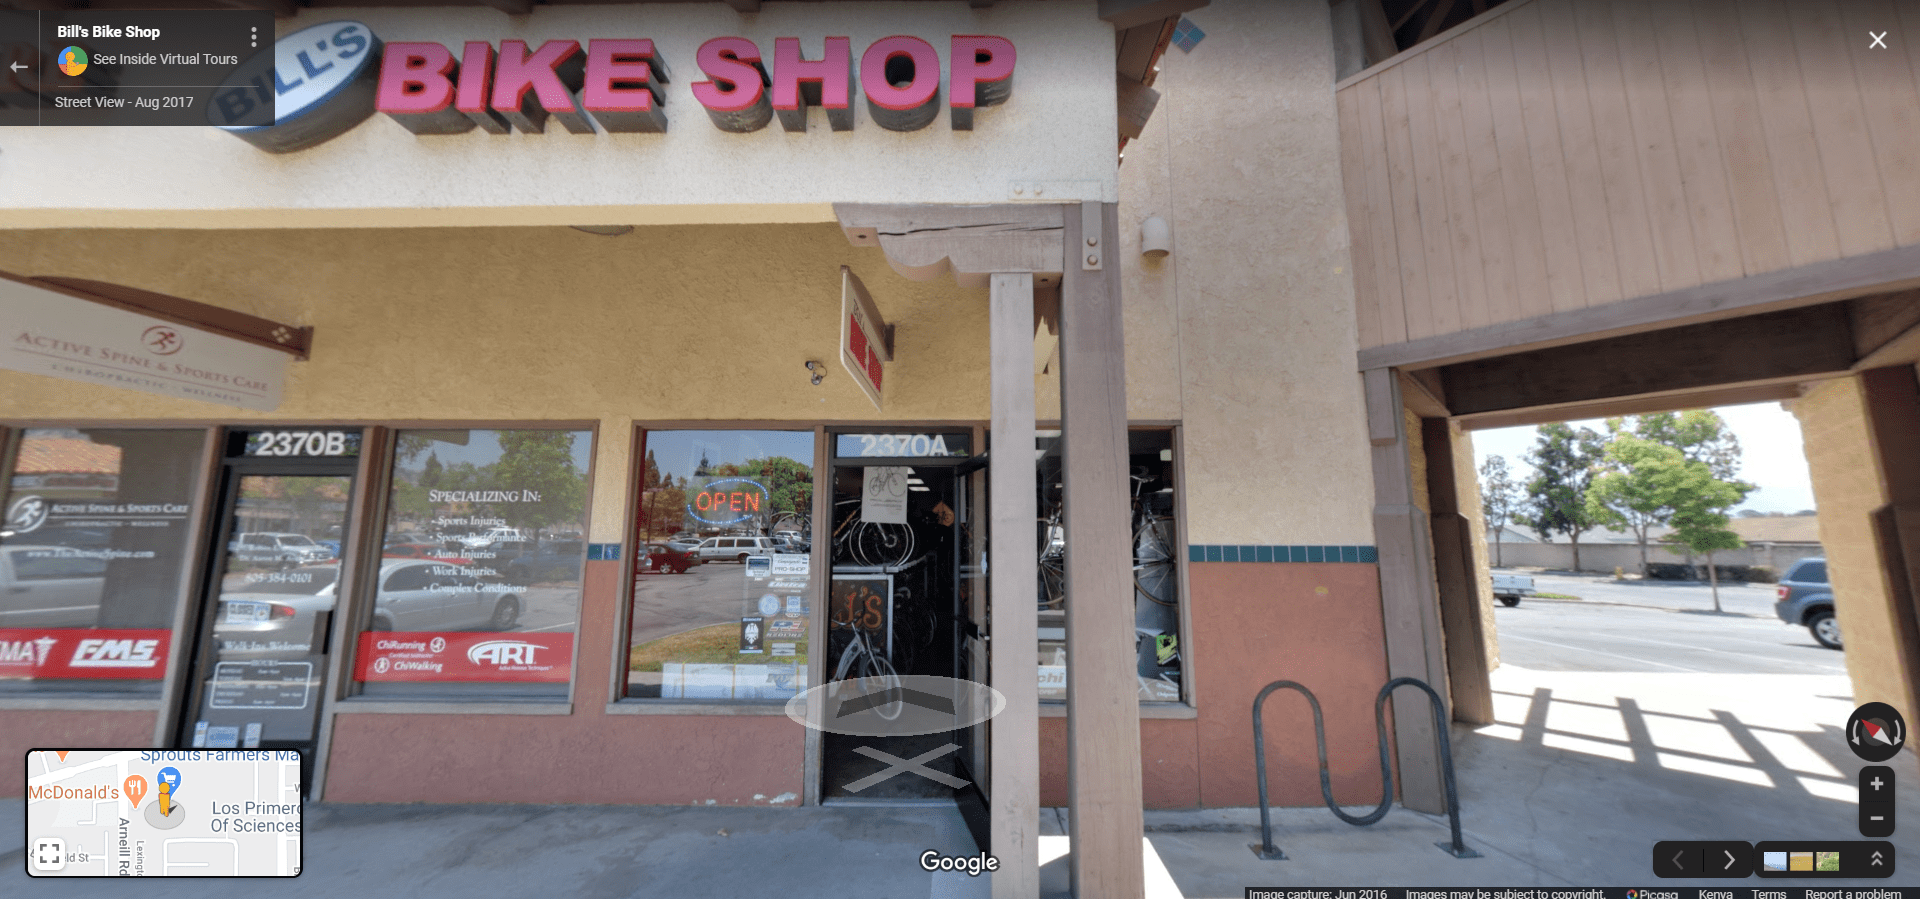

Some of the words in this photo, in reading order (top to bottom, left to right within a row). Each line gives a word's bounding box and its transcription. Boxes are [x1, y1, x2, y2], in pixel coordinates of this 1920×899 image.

[216, 26, 367, 124] BILL'S
[376, 38, 657, 114] BIKE
[691, 34, 1017, 111] SHOP
[15, 332, 92, 357] ACTIVE
[100, 347, 151, 369] SPINE
[156, 361, 168, 372] &
[173, 363, 230, 384] SPORTS
[233, 375, 269, 393] CARE
[255, 431, 346, 456] 2370B
[860, 434, 949, 457] 2370A
[428, 489, 519, 503] SPECIALIZING
[695, 491, 760, 512] OPEN
[438, 515, 467, 527] Sports
[470, 515, 507, 527] Injuries
[433, 550, 458, 559] Auto
[461, 550, 497, 561] Injuries
[433, 566, 458, 576] Work
[461, 566, 497, 578] Injuries
[430, 583, 472, 597] Complex
[474, 583, 528, 594] Conditions
[71, 639, 159, 667] FMS
[468, 641, 537, 666] ART
